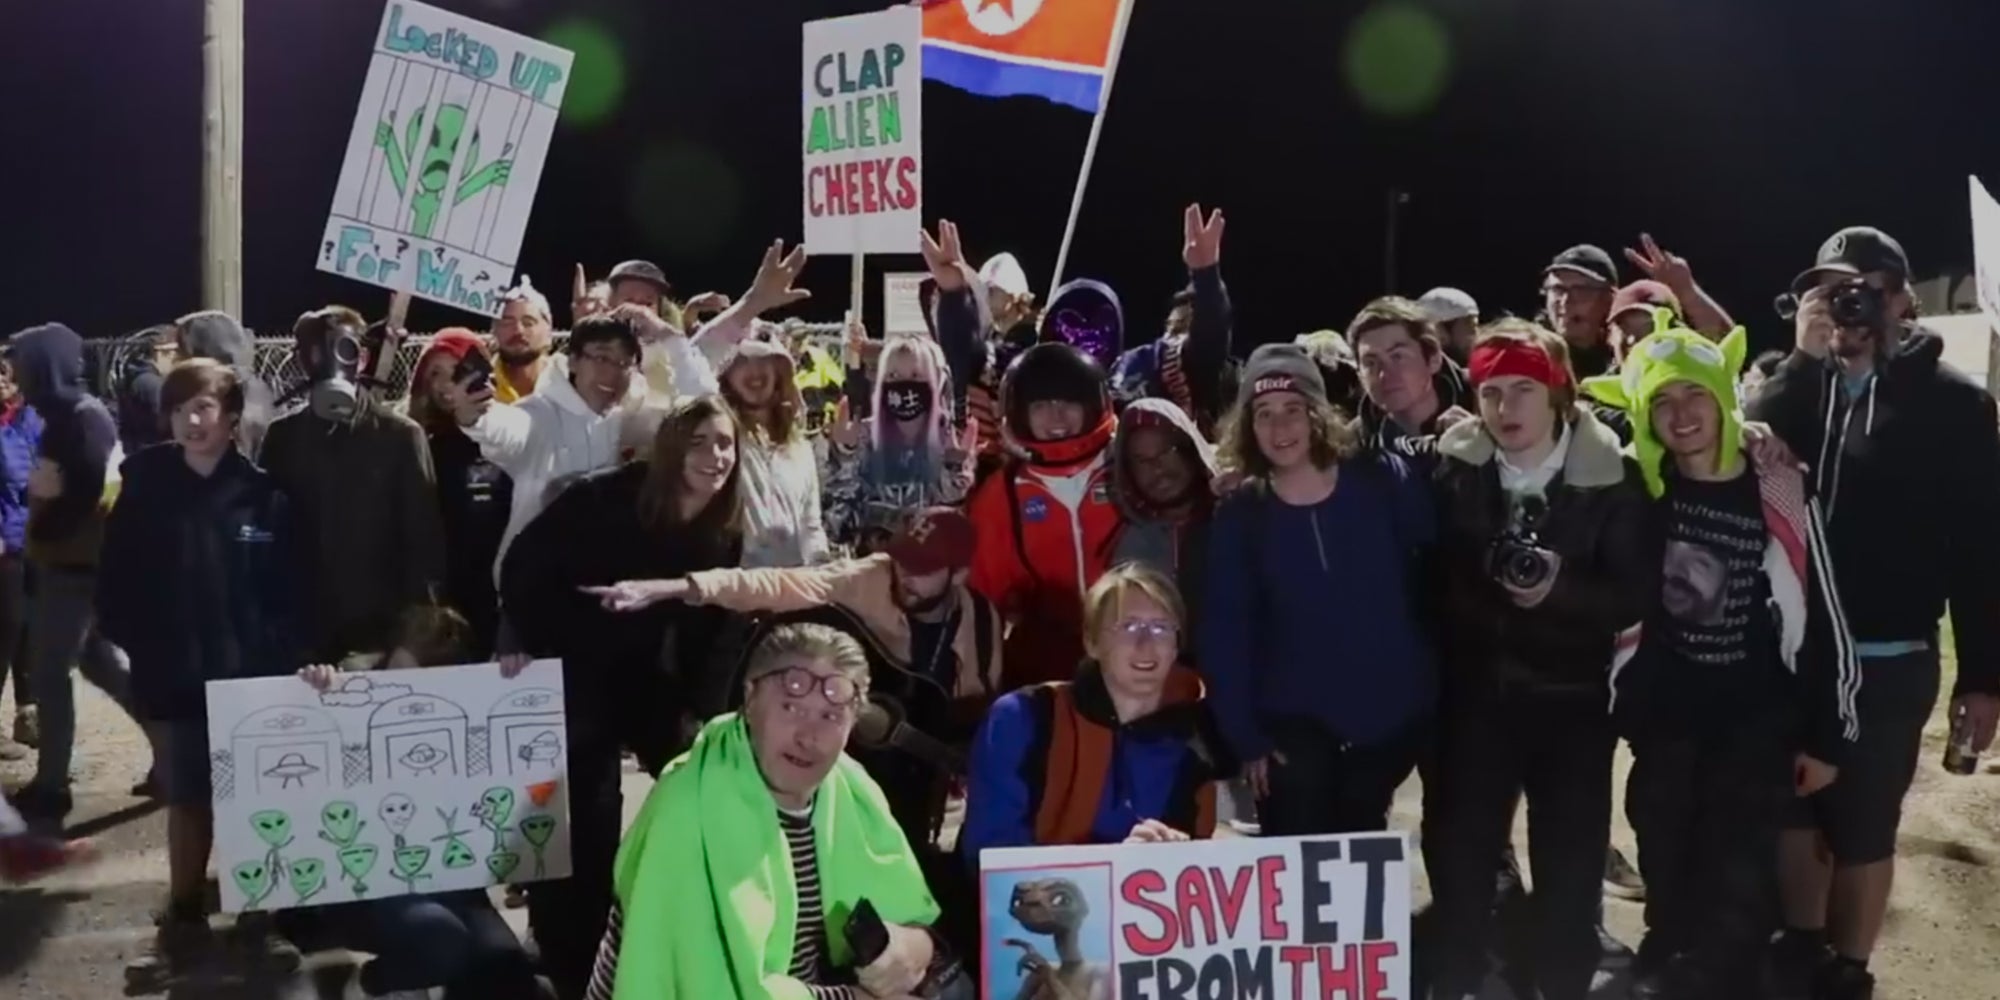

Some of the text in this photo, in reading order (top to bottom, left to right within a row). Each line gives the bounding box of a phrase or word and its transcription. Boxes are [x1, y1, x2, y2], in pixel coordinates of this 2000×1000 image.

[509, 51, 563, 100] UP
[814, 43, 905, 98] CLAP
[806, 91, 902, 154] ALIEN
[808, 156, 917, 217] CHEEKS
[335, 225, 401, 277] For
[1255, 377, 1291, 393] Elixir
[1120, 837, 1404, 955] SAVE ET
[1119, 942, 1399, 1000] FROM THE
